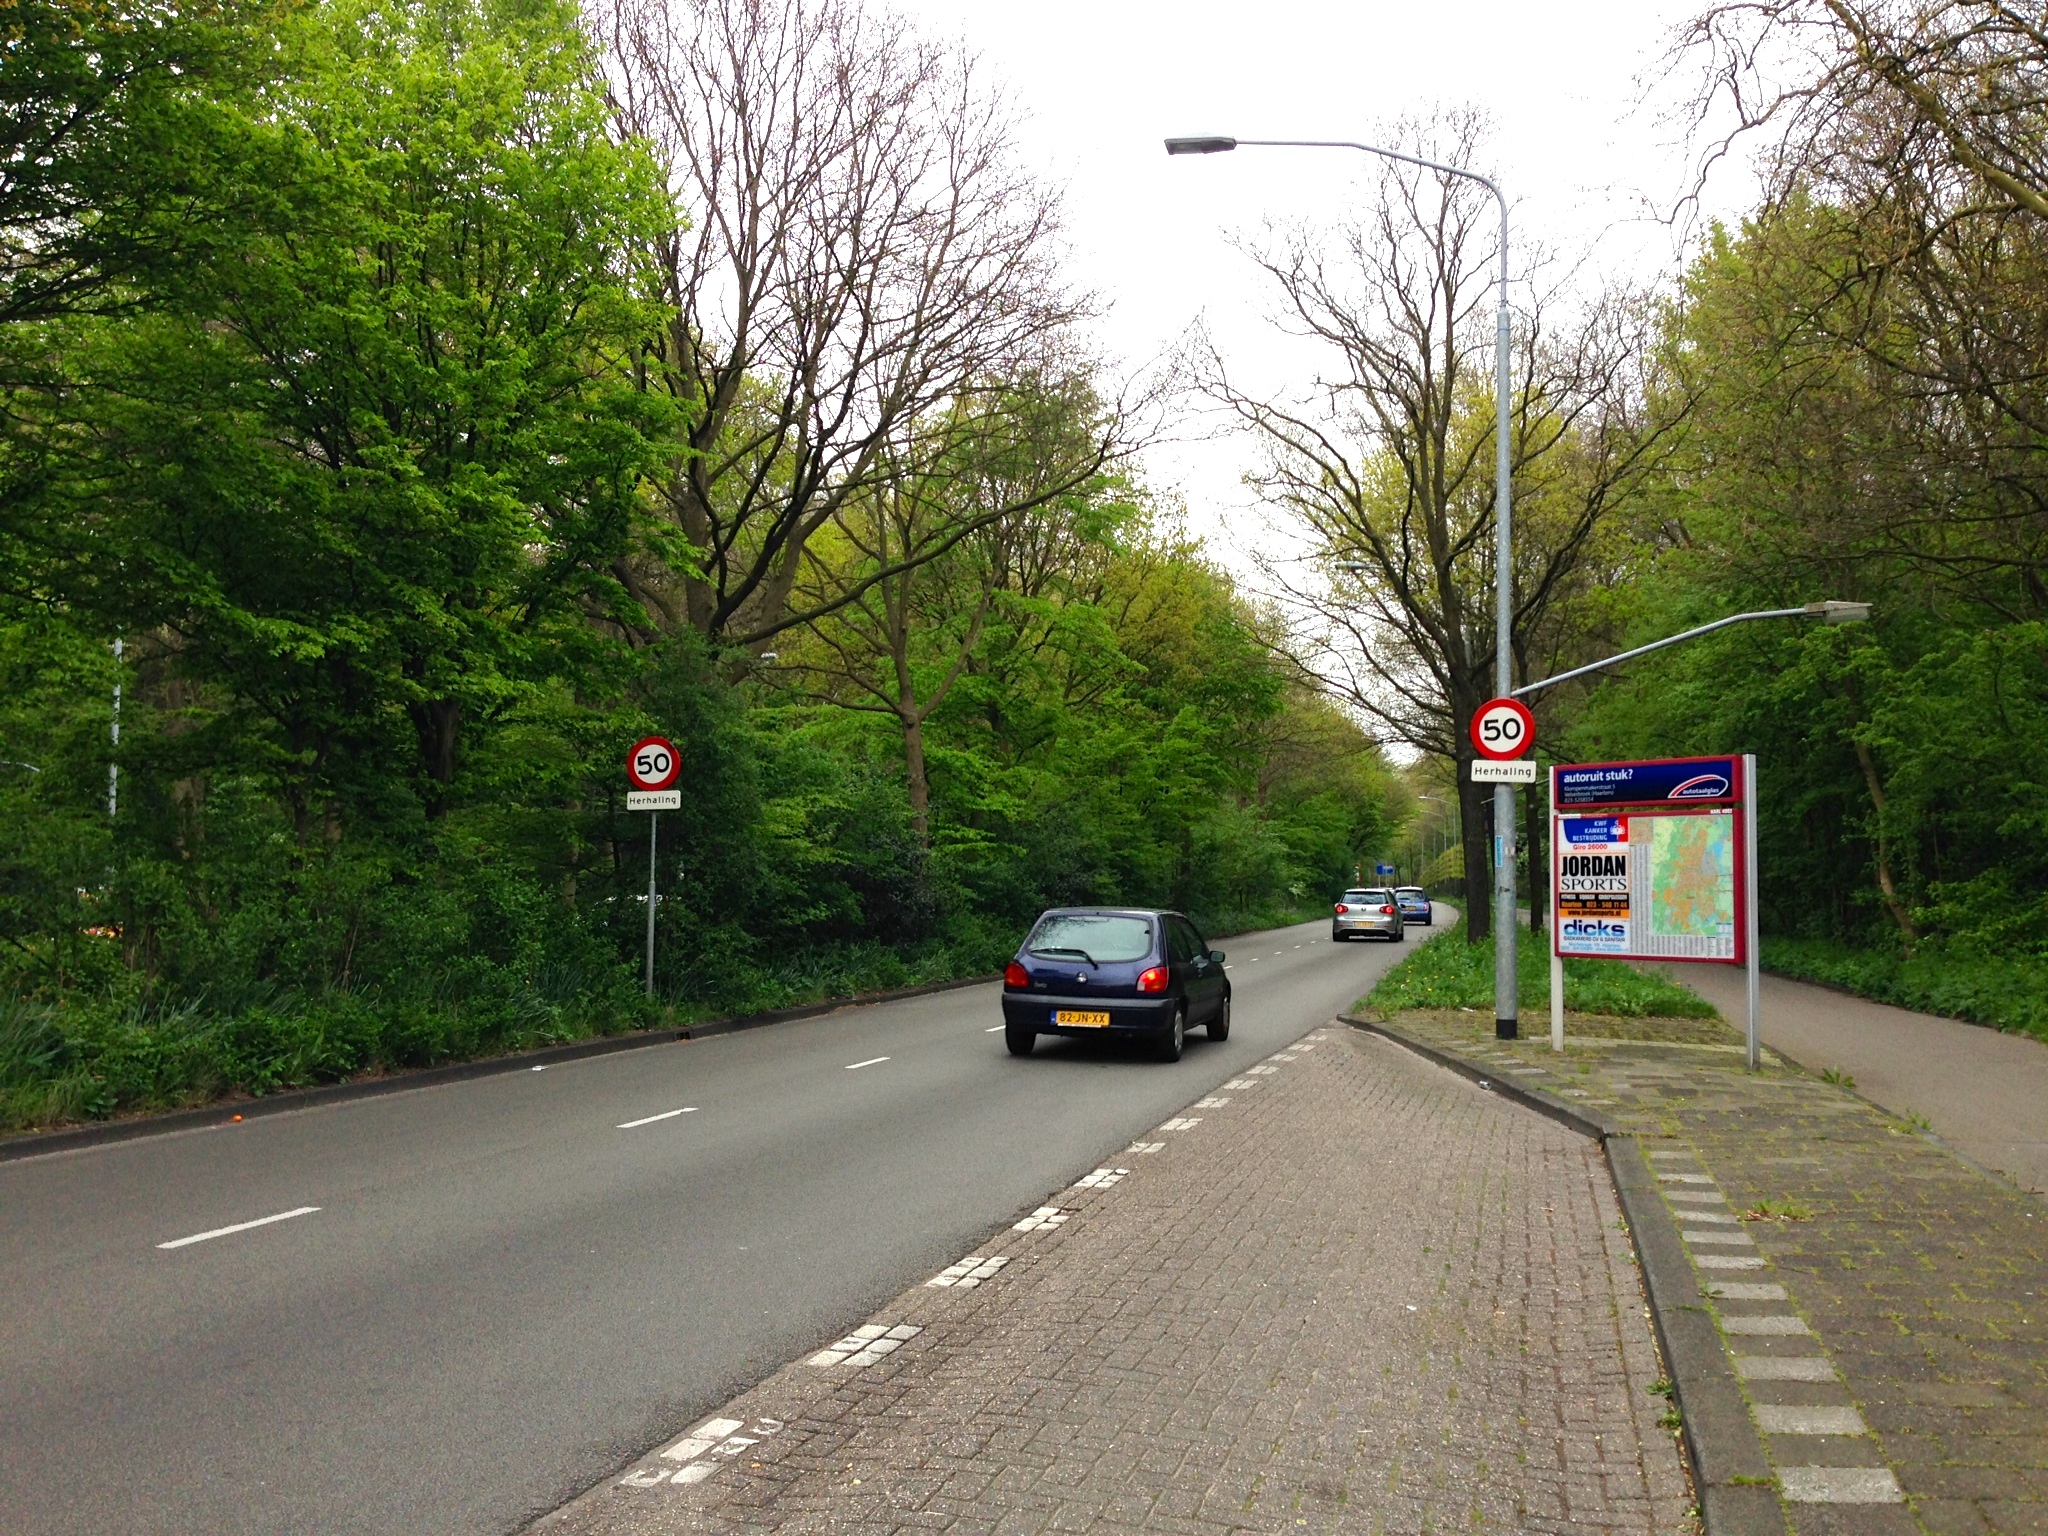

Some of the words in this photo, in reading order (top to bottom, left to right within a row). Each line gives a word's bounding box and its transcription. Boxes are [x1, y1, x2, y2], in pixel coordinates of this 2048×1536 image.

[1484, 717, 1521, 741] 50
[637, 753, 670, 775] 50
[1474, 767, 1532, 778] Herhaling
[1563, 770, 1604, 783] autoruit
[1605, 768, 1634, 781] stuk?
[1682, 787, 1719, 795] autotaalglas
[629, 796, 677, 805] Herhaling
[1572, 834, 1608, 842] BESTRIJDING
[1561, 855, 1626, 877] JORDAN
[1561, 878, 1627, 891] SPORTS
[1564, 919, 1625, 937] dicks
[1059, 1012, 1106, 1023] 82-JN-XX
